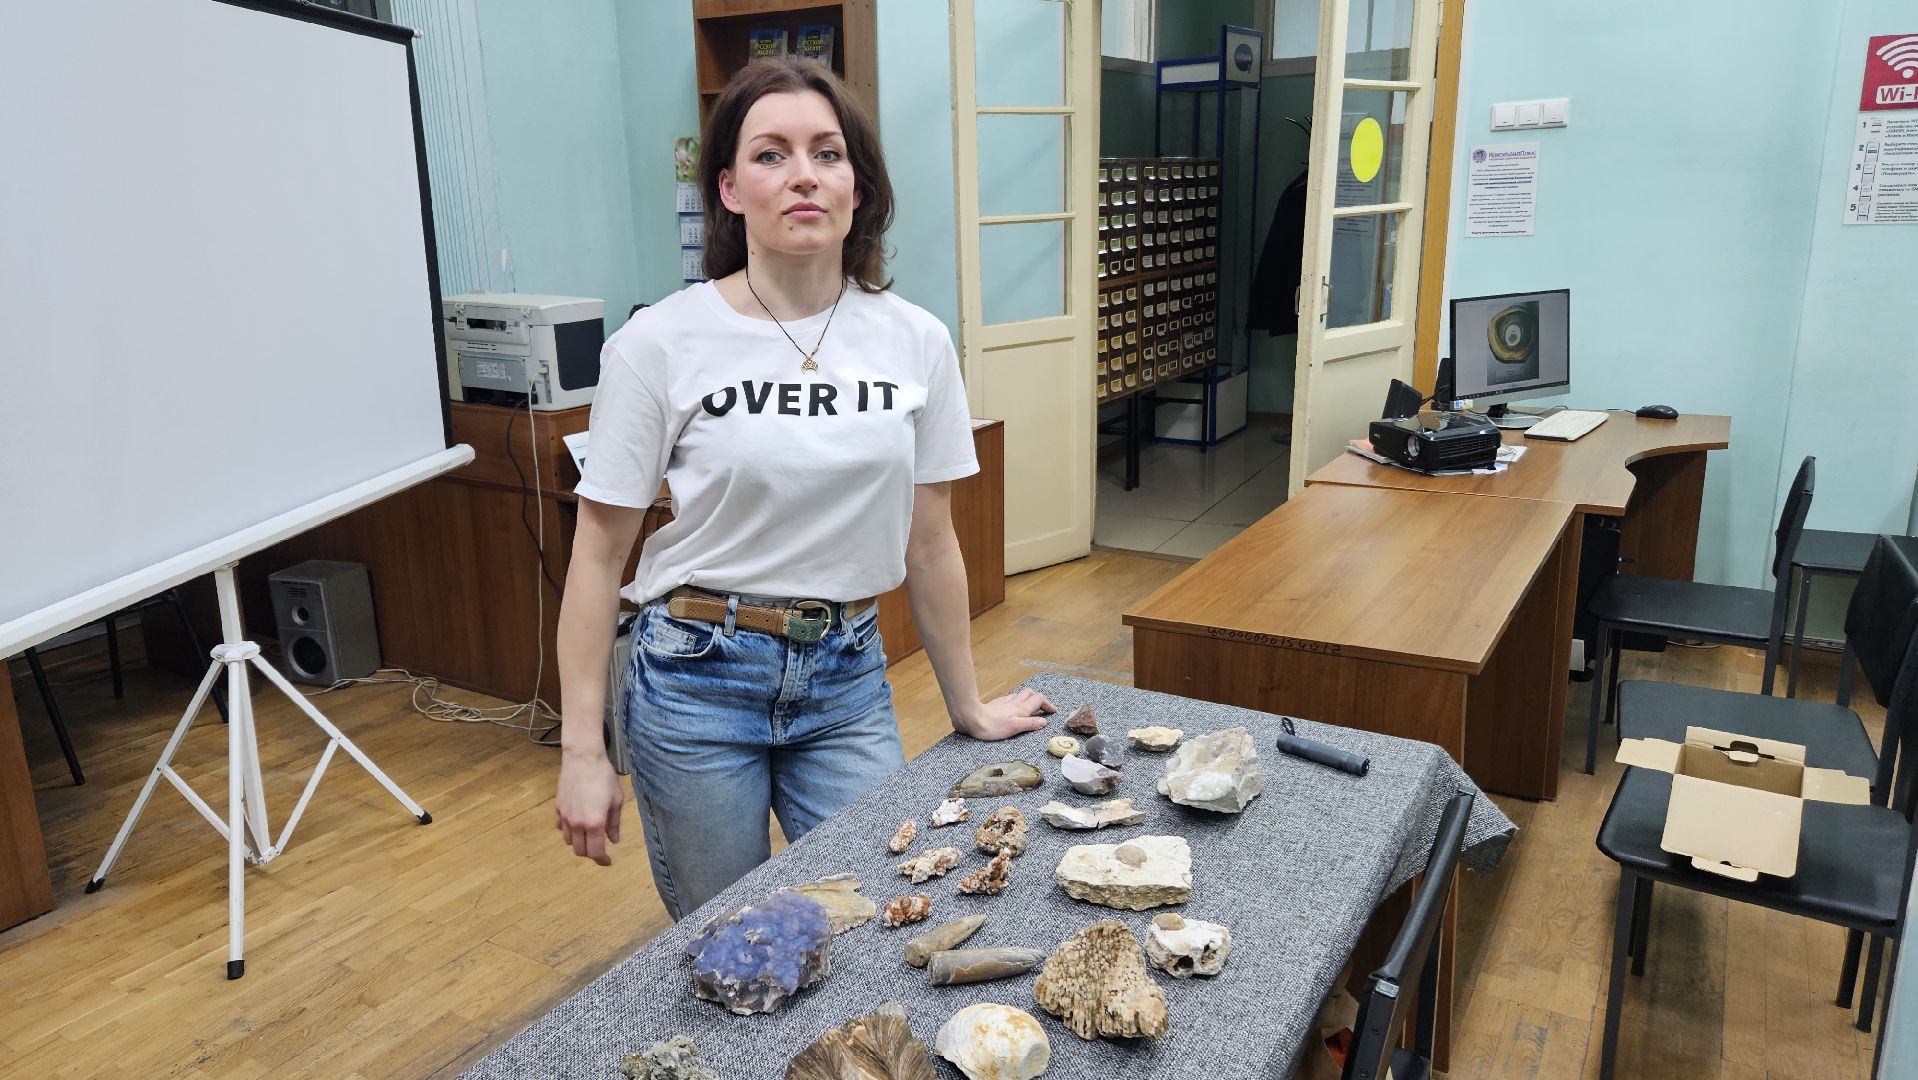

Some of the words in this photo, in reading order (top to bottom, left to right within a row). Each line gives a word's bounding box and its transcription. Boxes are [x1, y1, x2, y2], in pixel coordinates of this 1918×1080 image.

[1862, 121, 1867, 129] 1
[1858, 144, 1865, 152] 2
[1855, 163, 1862, 171] 3
[1852, 184, 1860, 192] 4
[1849, 203, 1857, 212] 5
[701, 380, 838, 417] OVER
[857, 380, 899, 412] IT
